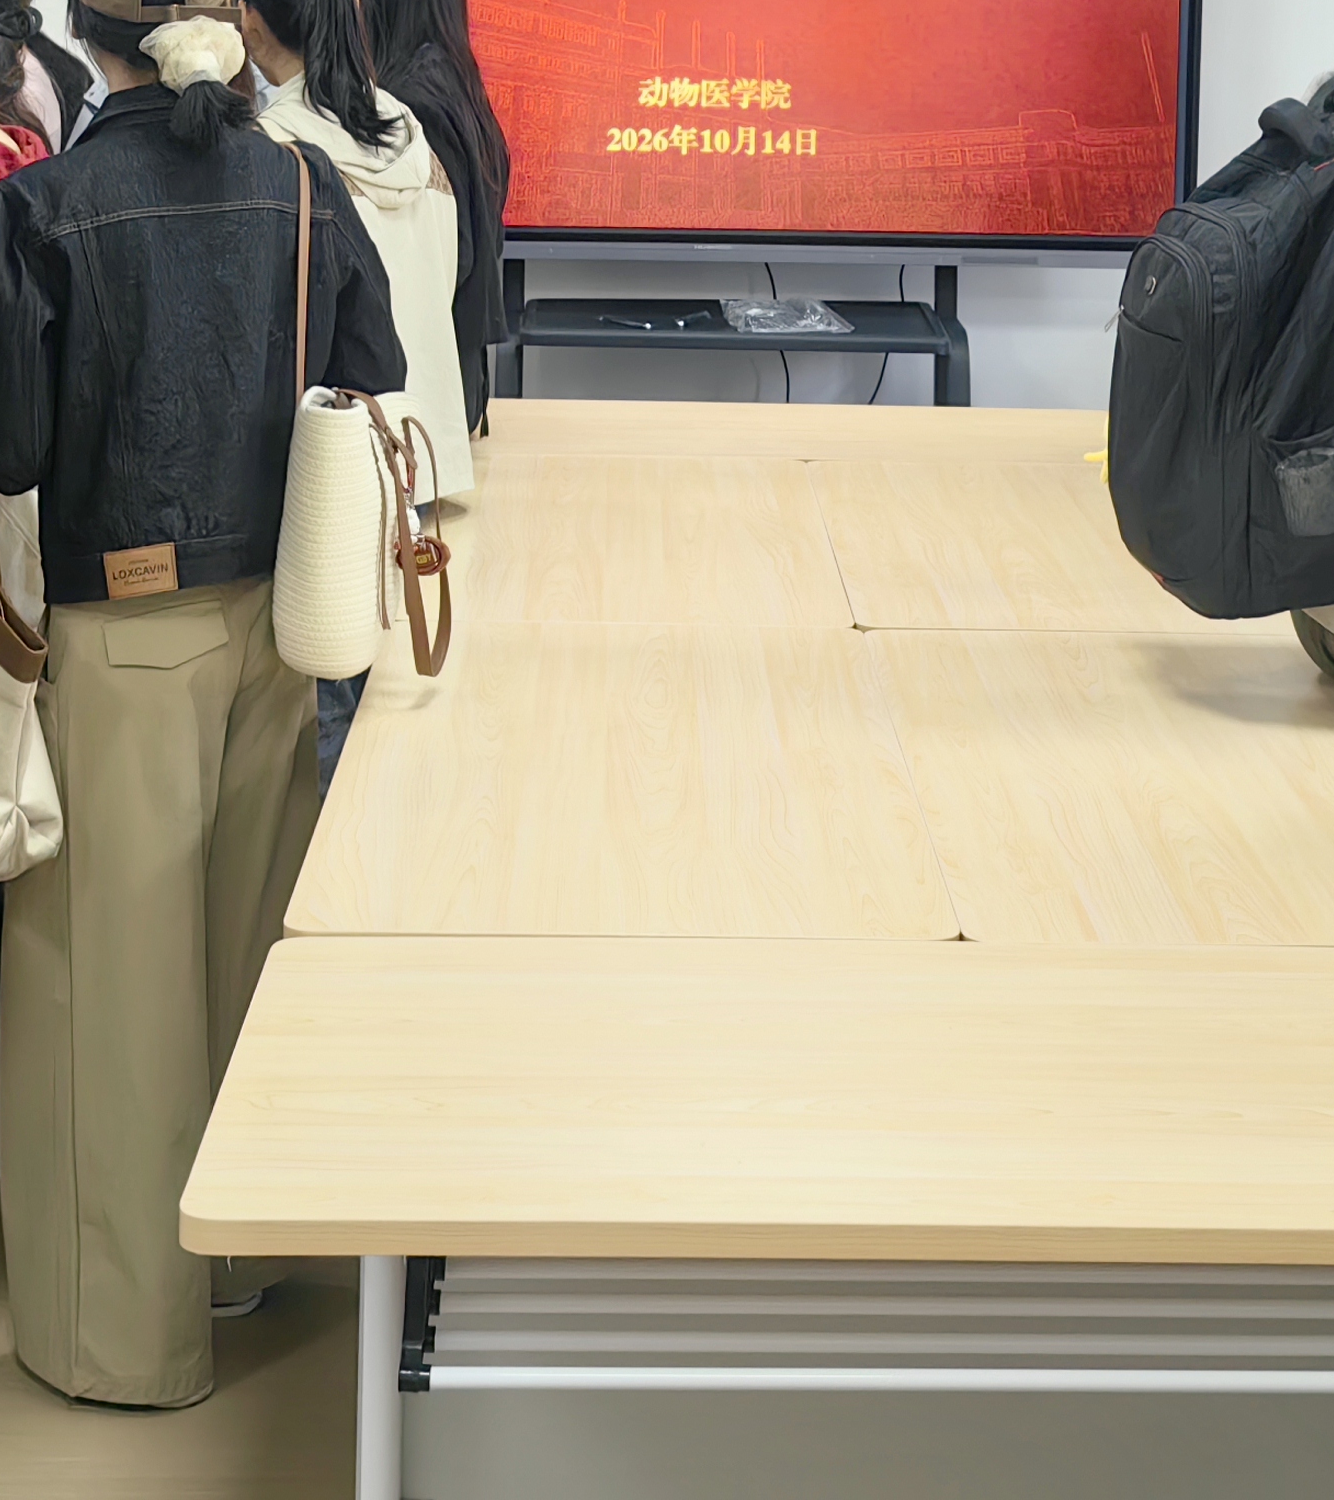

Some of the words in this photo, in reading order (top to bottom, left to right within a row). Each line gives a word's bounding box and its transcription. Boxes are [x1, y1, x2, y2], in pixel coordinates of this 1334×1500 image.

[638, 76, 792, 109] 动物医学院
[606, 125, 817, 155] 2026年10月14日
